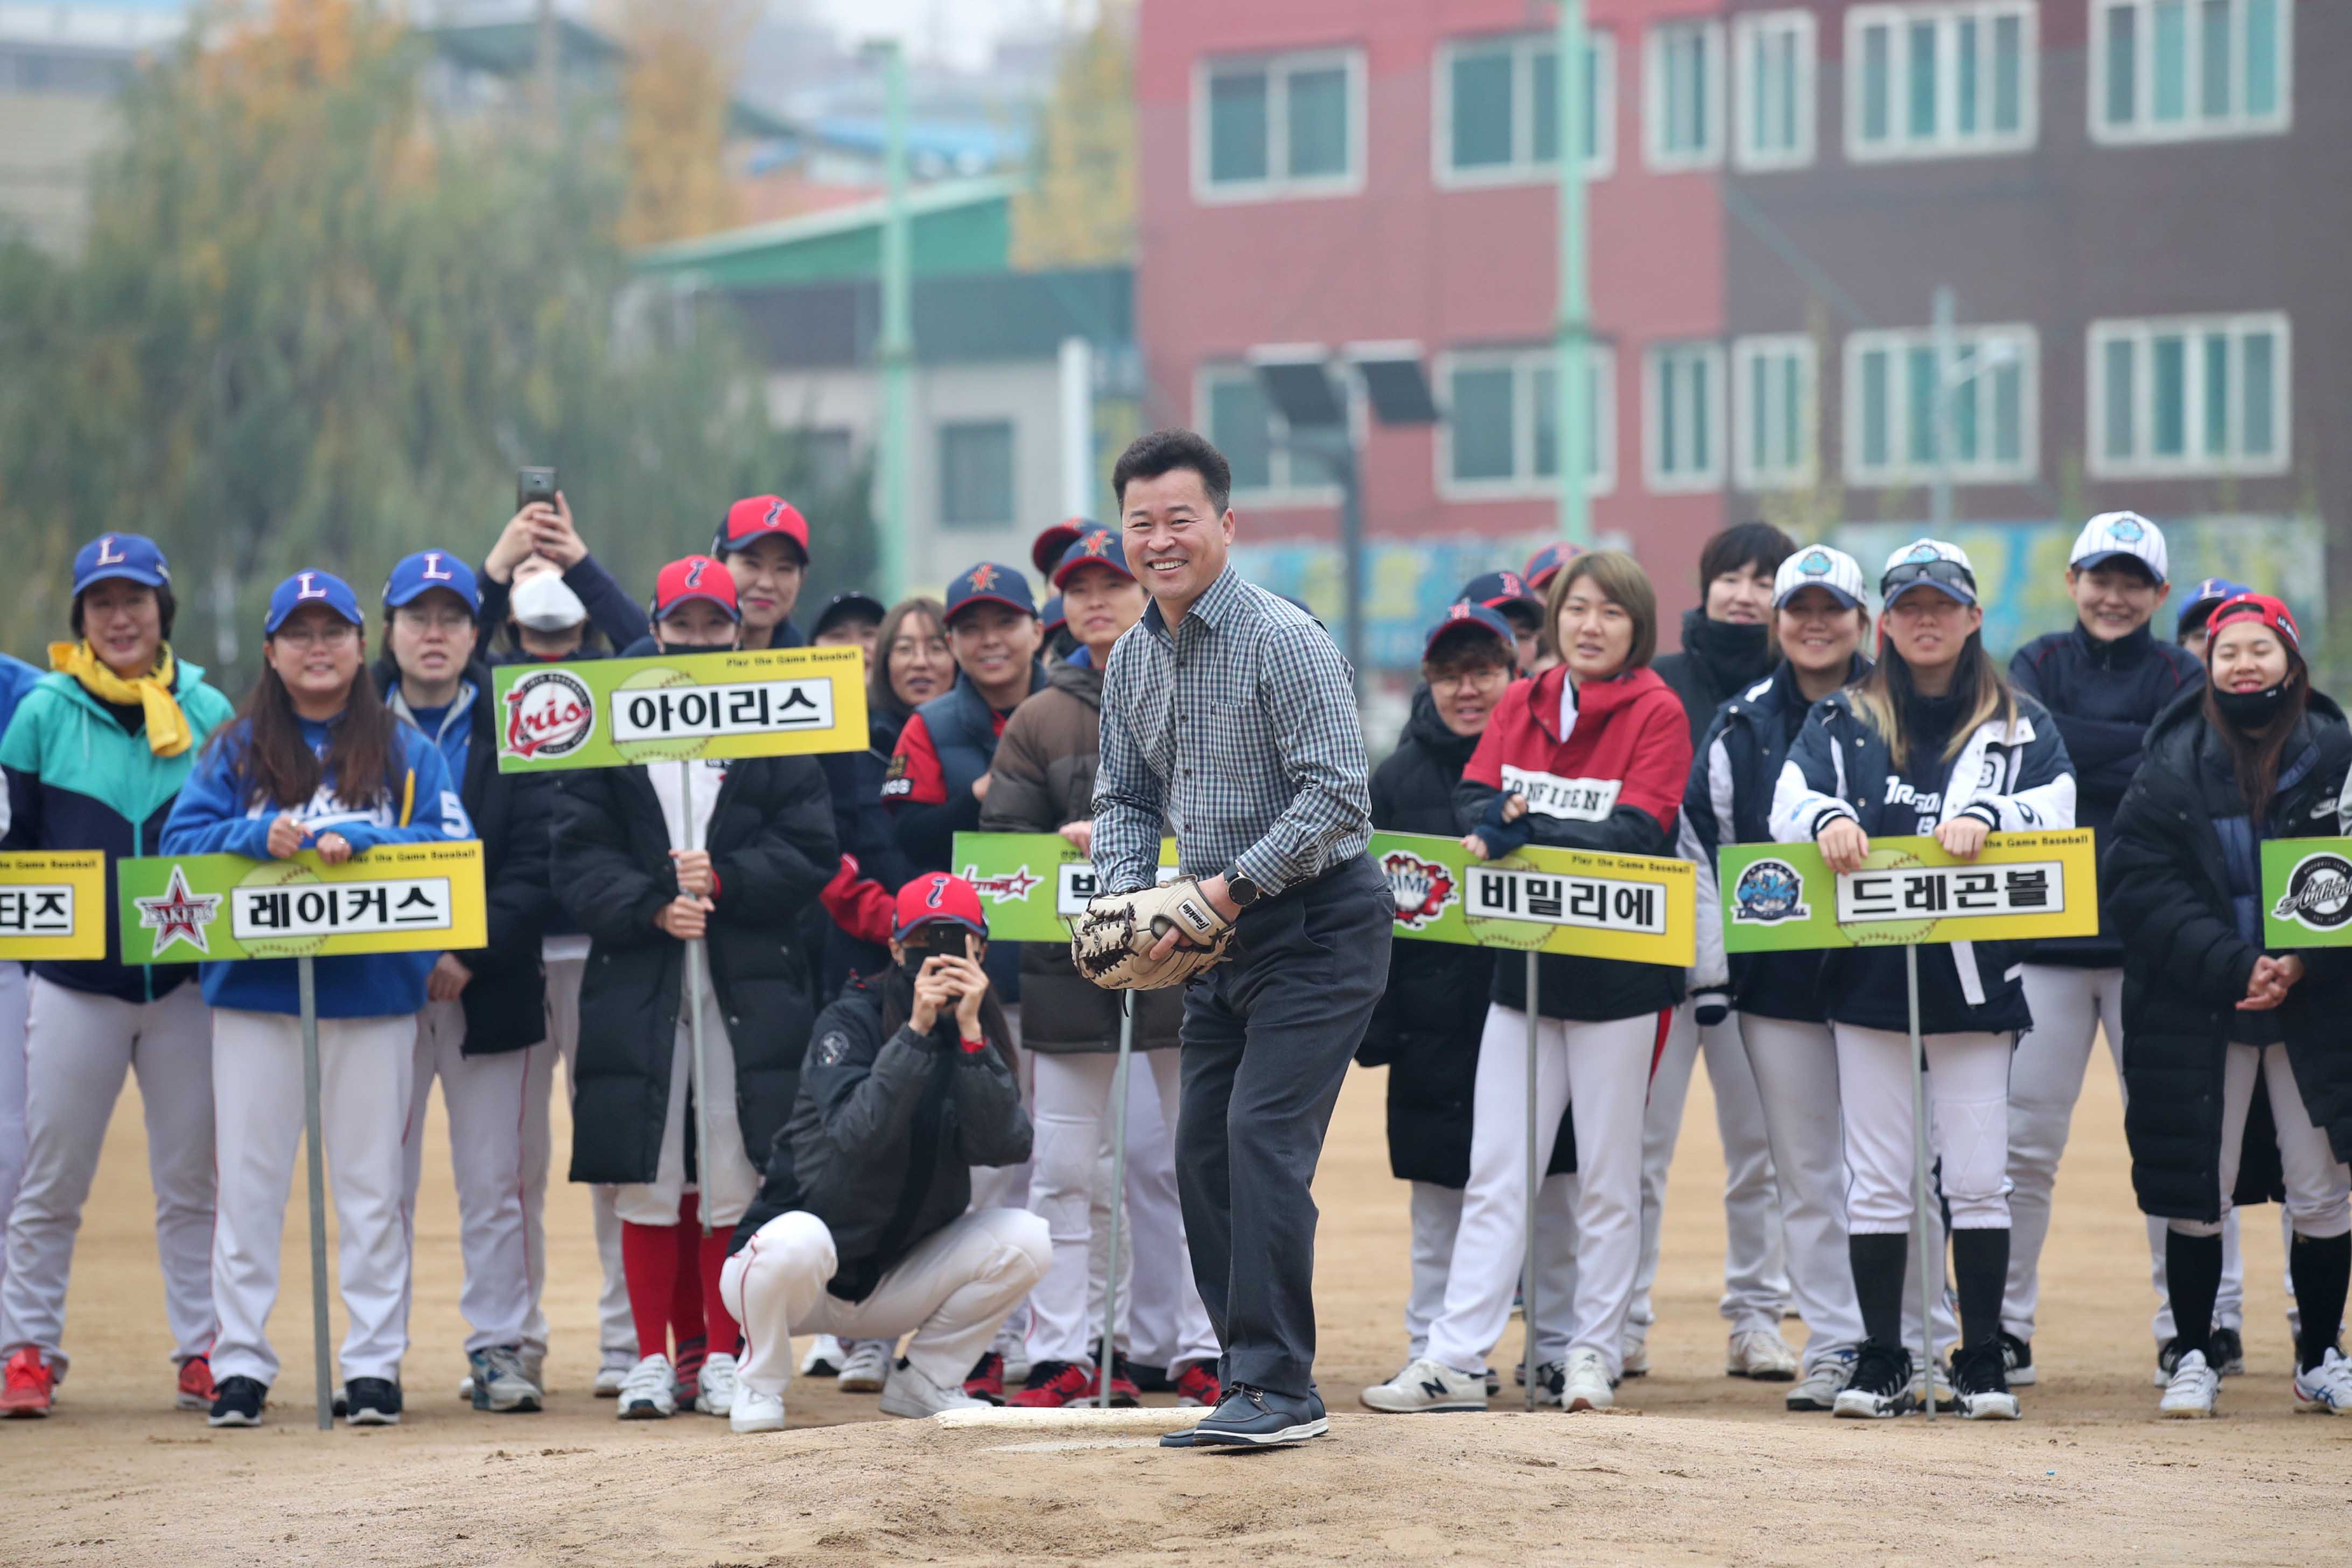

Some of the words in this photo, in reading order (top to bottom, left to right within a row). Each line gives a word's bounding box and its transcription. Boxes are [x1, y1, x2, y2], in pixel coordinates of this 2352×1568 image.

[96, 536, 127, 566] L
[423, 552, 452, 580] L
[297, 572, 327, 600] L
[2200, 577, 2227, 600] L
[727, 658, 749, 667] Play
[755, 657, 772, 666] the
[777, 655, 806, 664] Game
[810, 652, 856, 663] Baseball
[508, 690, 590, 752] Iris
[629, 688, 820, 731] 아이리스
[440, 790, 470, 839] 5
[375, 853, 392, 862] the
[397, 851, 425, 861] Game
[431, 849, 476, 860] Baseball
[1984, 838, 2002, 849] the
[2008, 837, 2037, 848] Game
[2042, 835, 2088, 845] Baseball
[51, 860, 96, 869] Baseball
[1572, 855, 1592, 866] Play
[1598, 857, 1613, 867] the
[1618, 860, 1646, 870] Game
[1649, 863, 1691, 873] Baseball
[1481, 874, 1654, 926] 비밀리에
[1853, 870, 2048, 914] 드레곤볼
[0, 892, 68, 929] 타즈
[249, 886, 438, 928] 레이커스
[1182, 904, 1210, 930] Franklin
